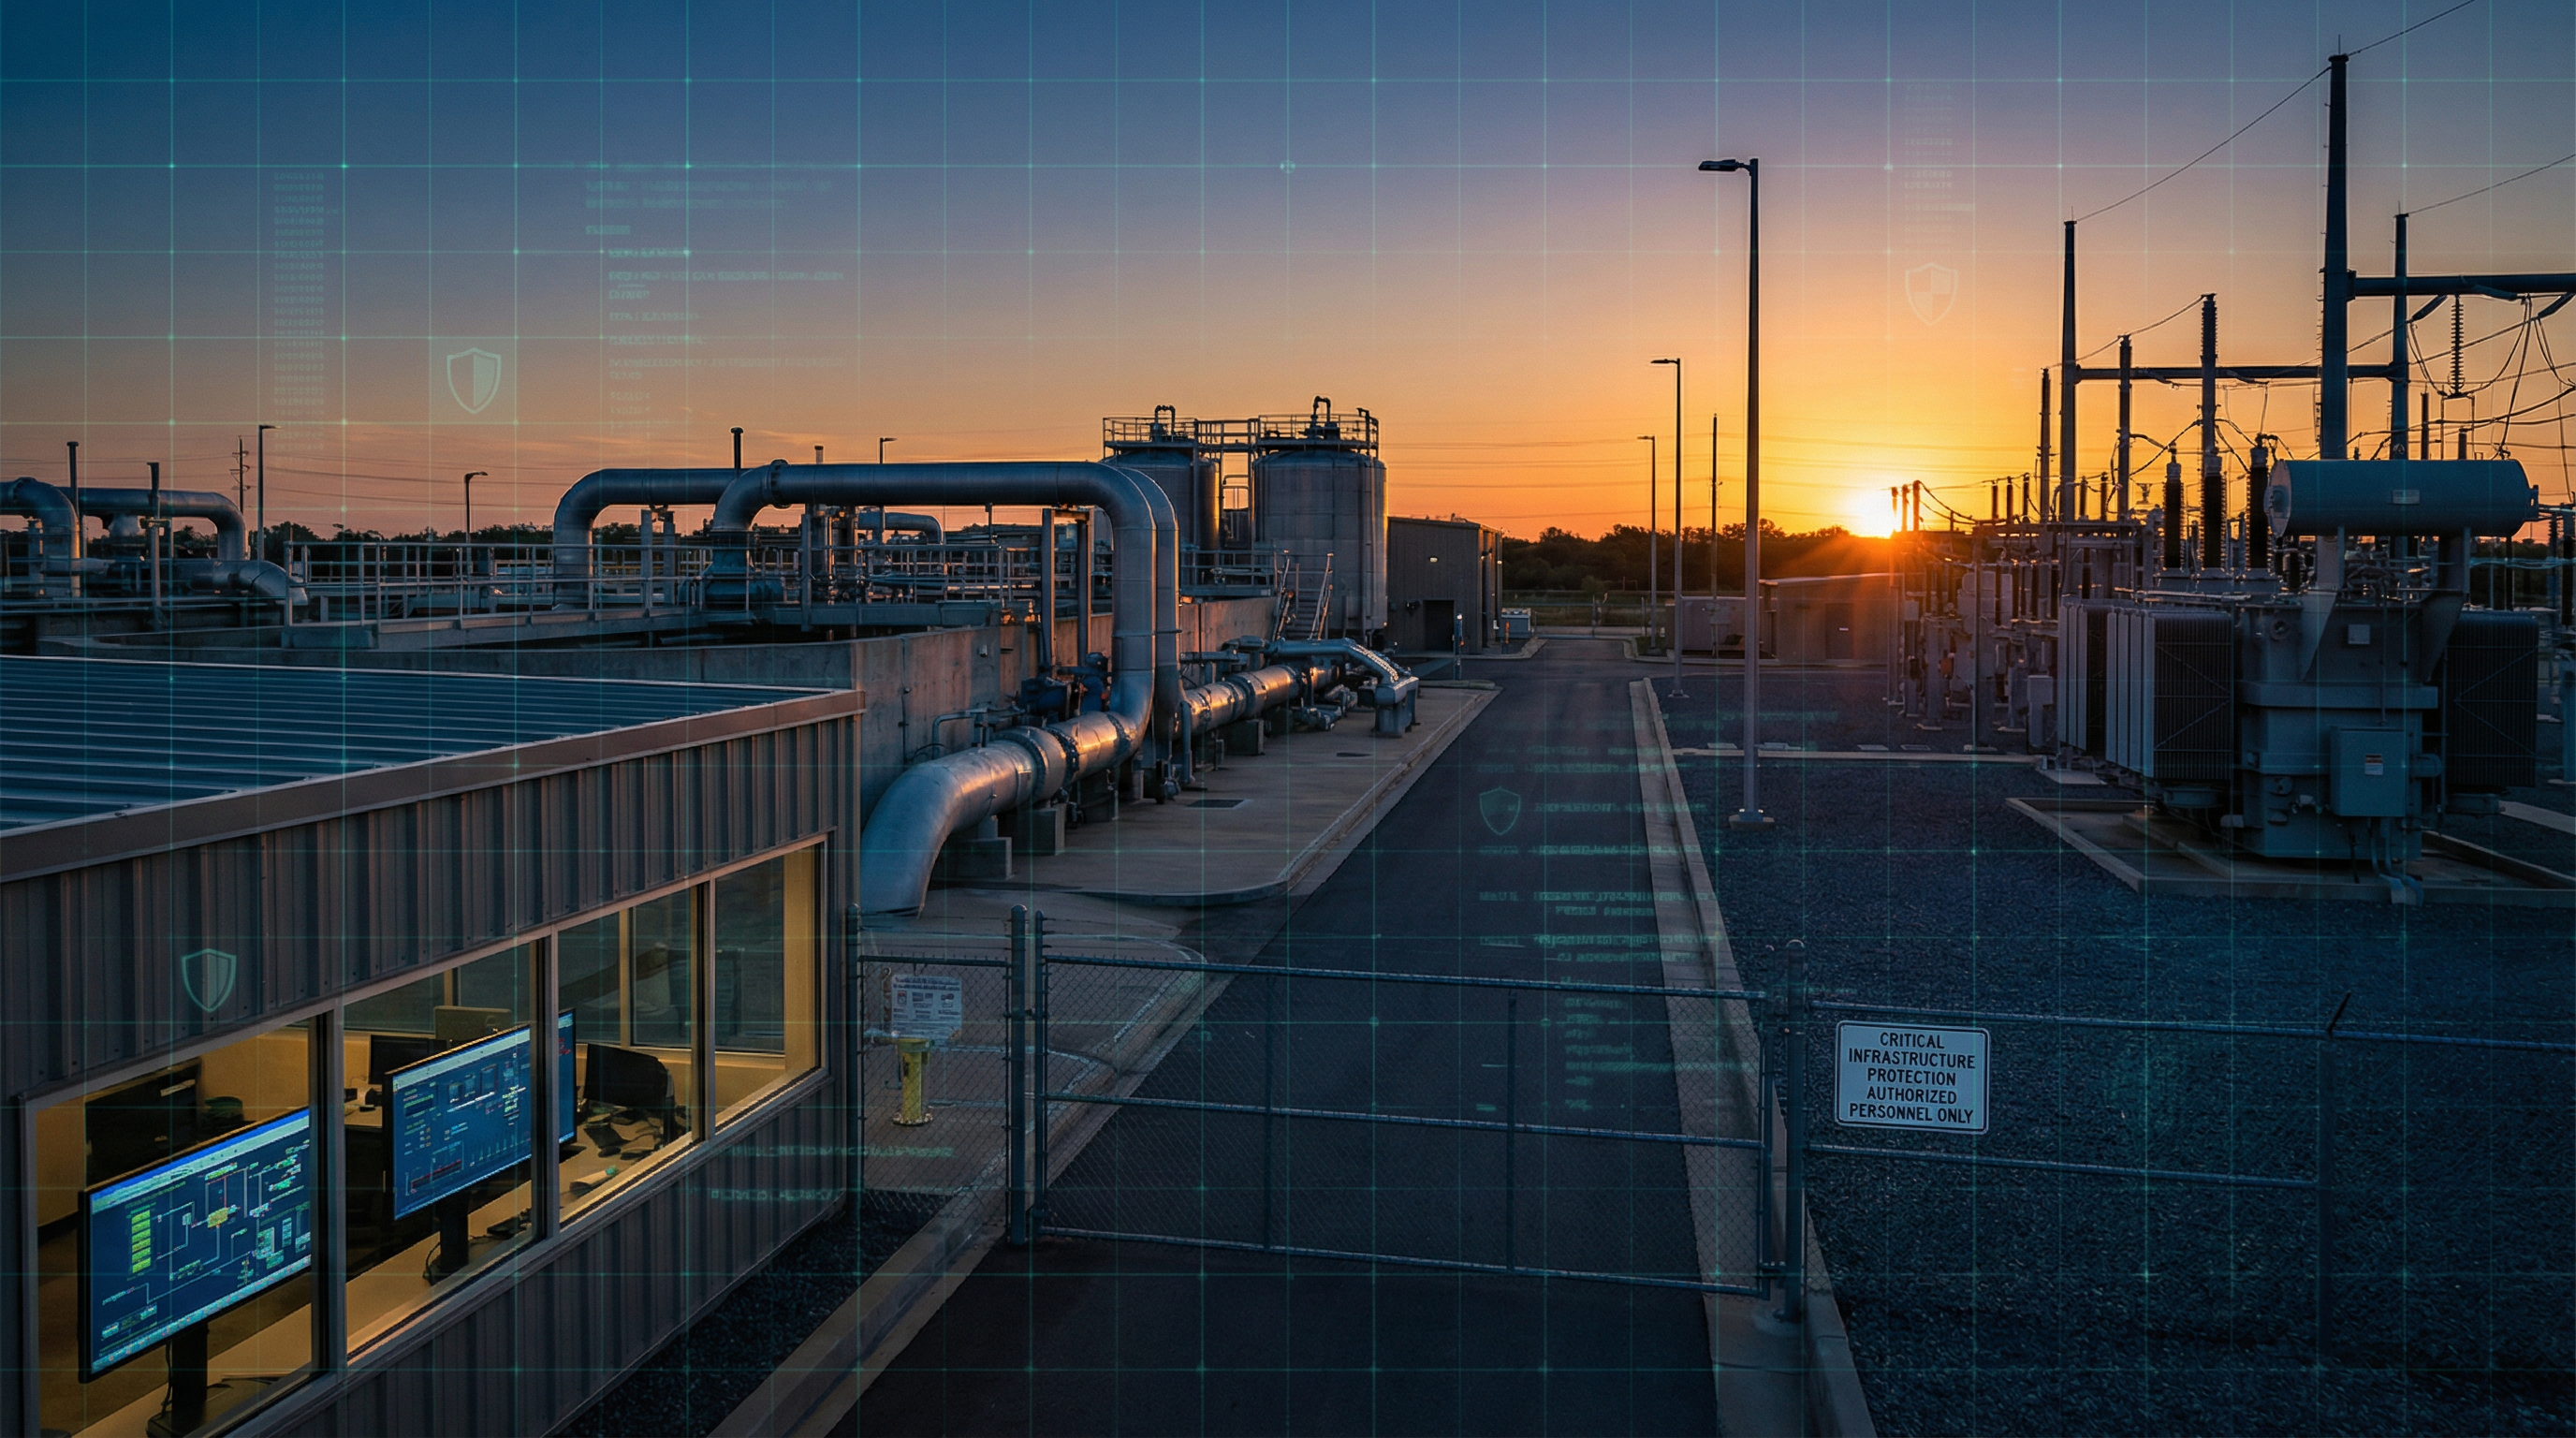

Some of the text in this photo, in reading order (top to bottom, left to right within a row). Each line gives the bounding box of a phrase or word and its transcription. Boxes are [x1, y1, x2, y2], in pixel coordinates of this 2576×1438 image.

[1880, 1032, 1945, 1049] CRITICAL
[1849, 1048, 1975, 1069] INFRASTRUCTURE
[1867, 1067, 1956, 1086] PROTECTION
[1866, 1086, 1957, 1105] AUTHORIZED
[1850, 1103, 1974, 1124] PERSONNEL ONLY
